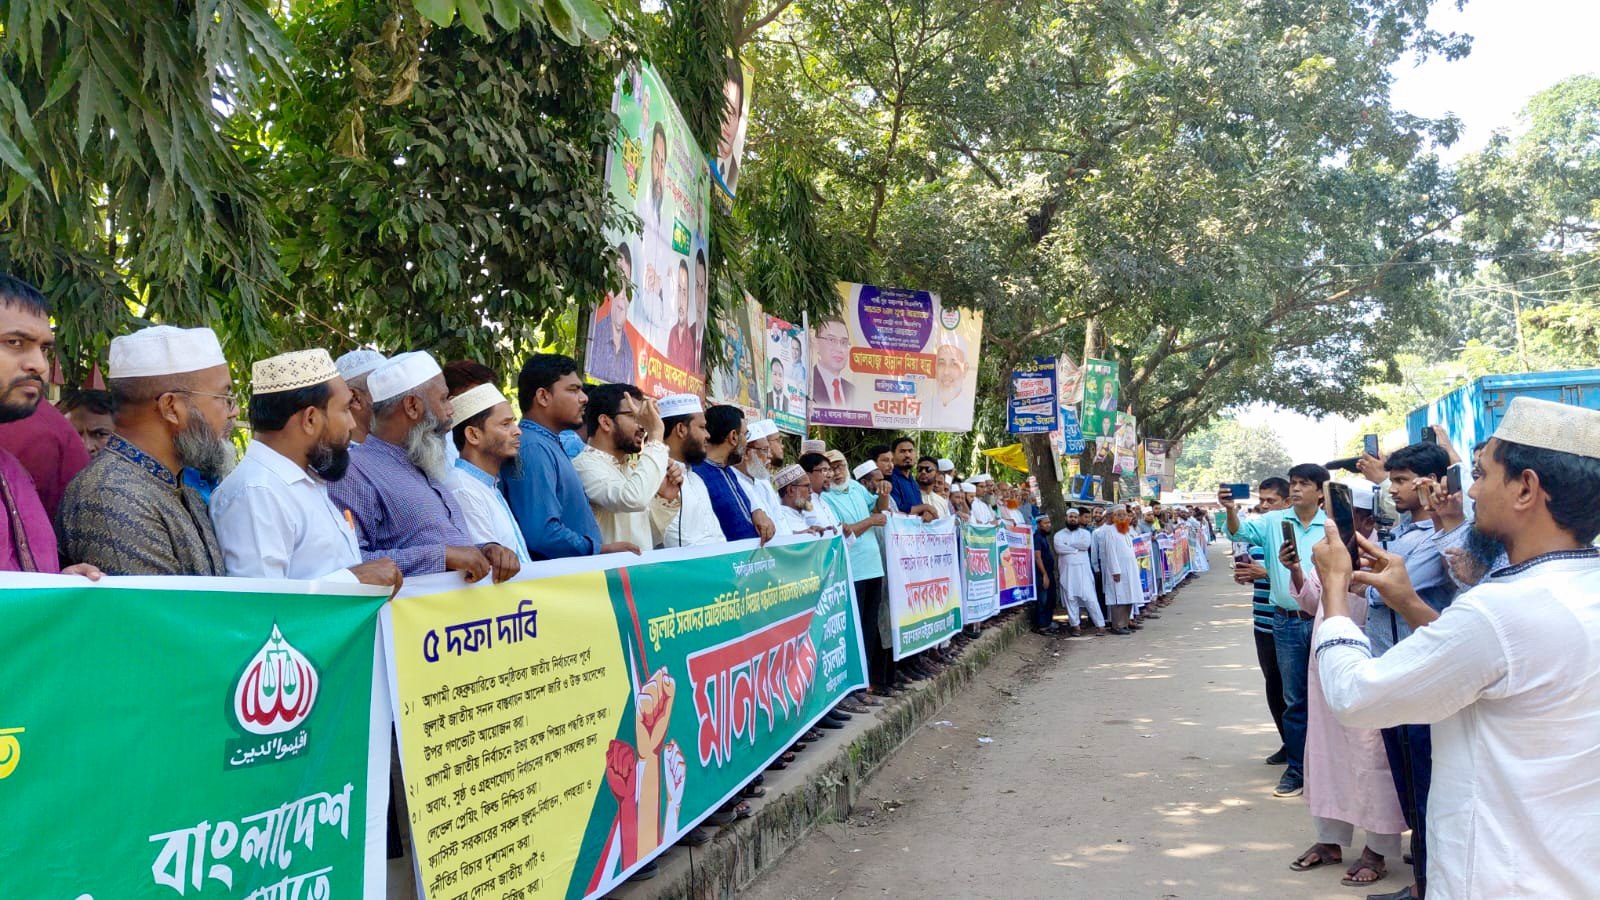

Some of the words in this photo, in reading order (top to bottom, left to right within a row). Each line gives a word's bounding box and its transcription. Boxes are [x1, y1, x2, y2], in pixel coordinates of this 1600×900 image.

[873, 395, 923, 417] এমপি
[424, 629, 440, 663] ৫
[445, 617, 493, 657] দফা
[496, 599, 538, 645] দাবি
[648, 607, 676, 652] জুলাই
[676, 607, 704, 635] সনদের
[422, 684, 450, 708] আগামী
[529, 658, 552, 678] জাতীয়
[687, 607, 817, 768] মানববন্ধন
[423, 714, 447, 738] জুলাই
[447, 705, 475, 728] জাতীয়
[475, 701, 495, 718] সনদ
[523, 684, 547, 702] আদেশ
[547, 676, 562, 695] জারি
[562, 679, 570, 691] ও
[423, 743, 445, 762] উপর
[445, 730, 477, 755] গণভোট
[477, 720, 512, 743] আয়োজন
[424, 763, 452, 788] আগামী
[453, 753, 481, 777] জাতীয়
[481, 744, 513, 769] নির্বাচনে
[469, 784, 477, 797] ও
[149, 782, 354, 897] বাংলাদেশ
[427, 818, 454, 844] লেভেল
[459, 825, 499, 853] সরকারের
[499, 815, 521, 834] সকল
[586, 779, 594, 791] ও
[459, 860, 483, 881] বিচার
[484, 842, 516, 873] দৃশ্যমান
[471, 877, 497, 900] দোসর
[498, 863, 524, 886] জাতীয়
[539, 850, 546, 863] ও
